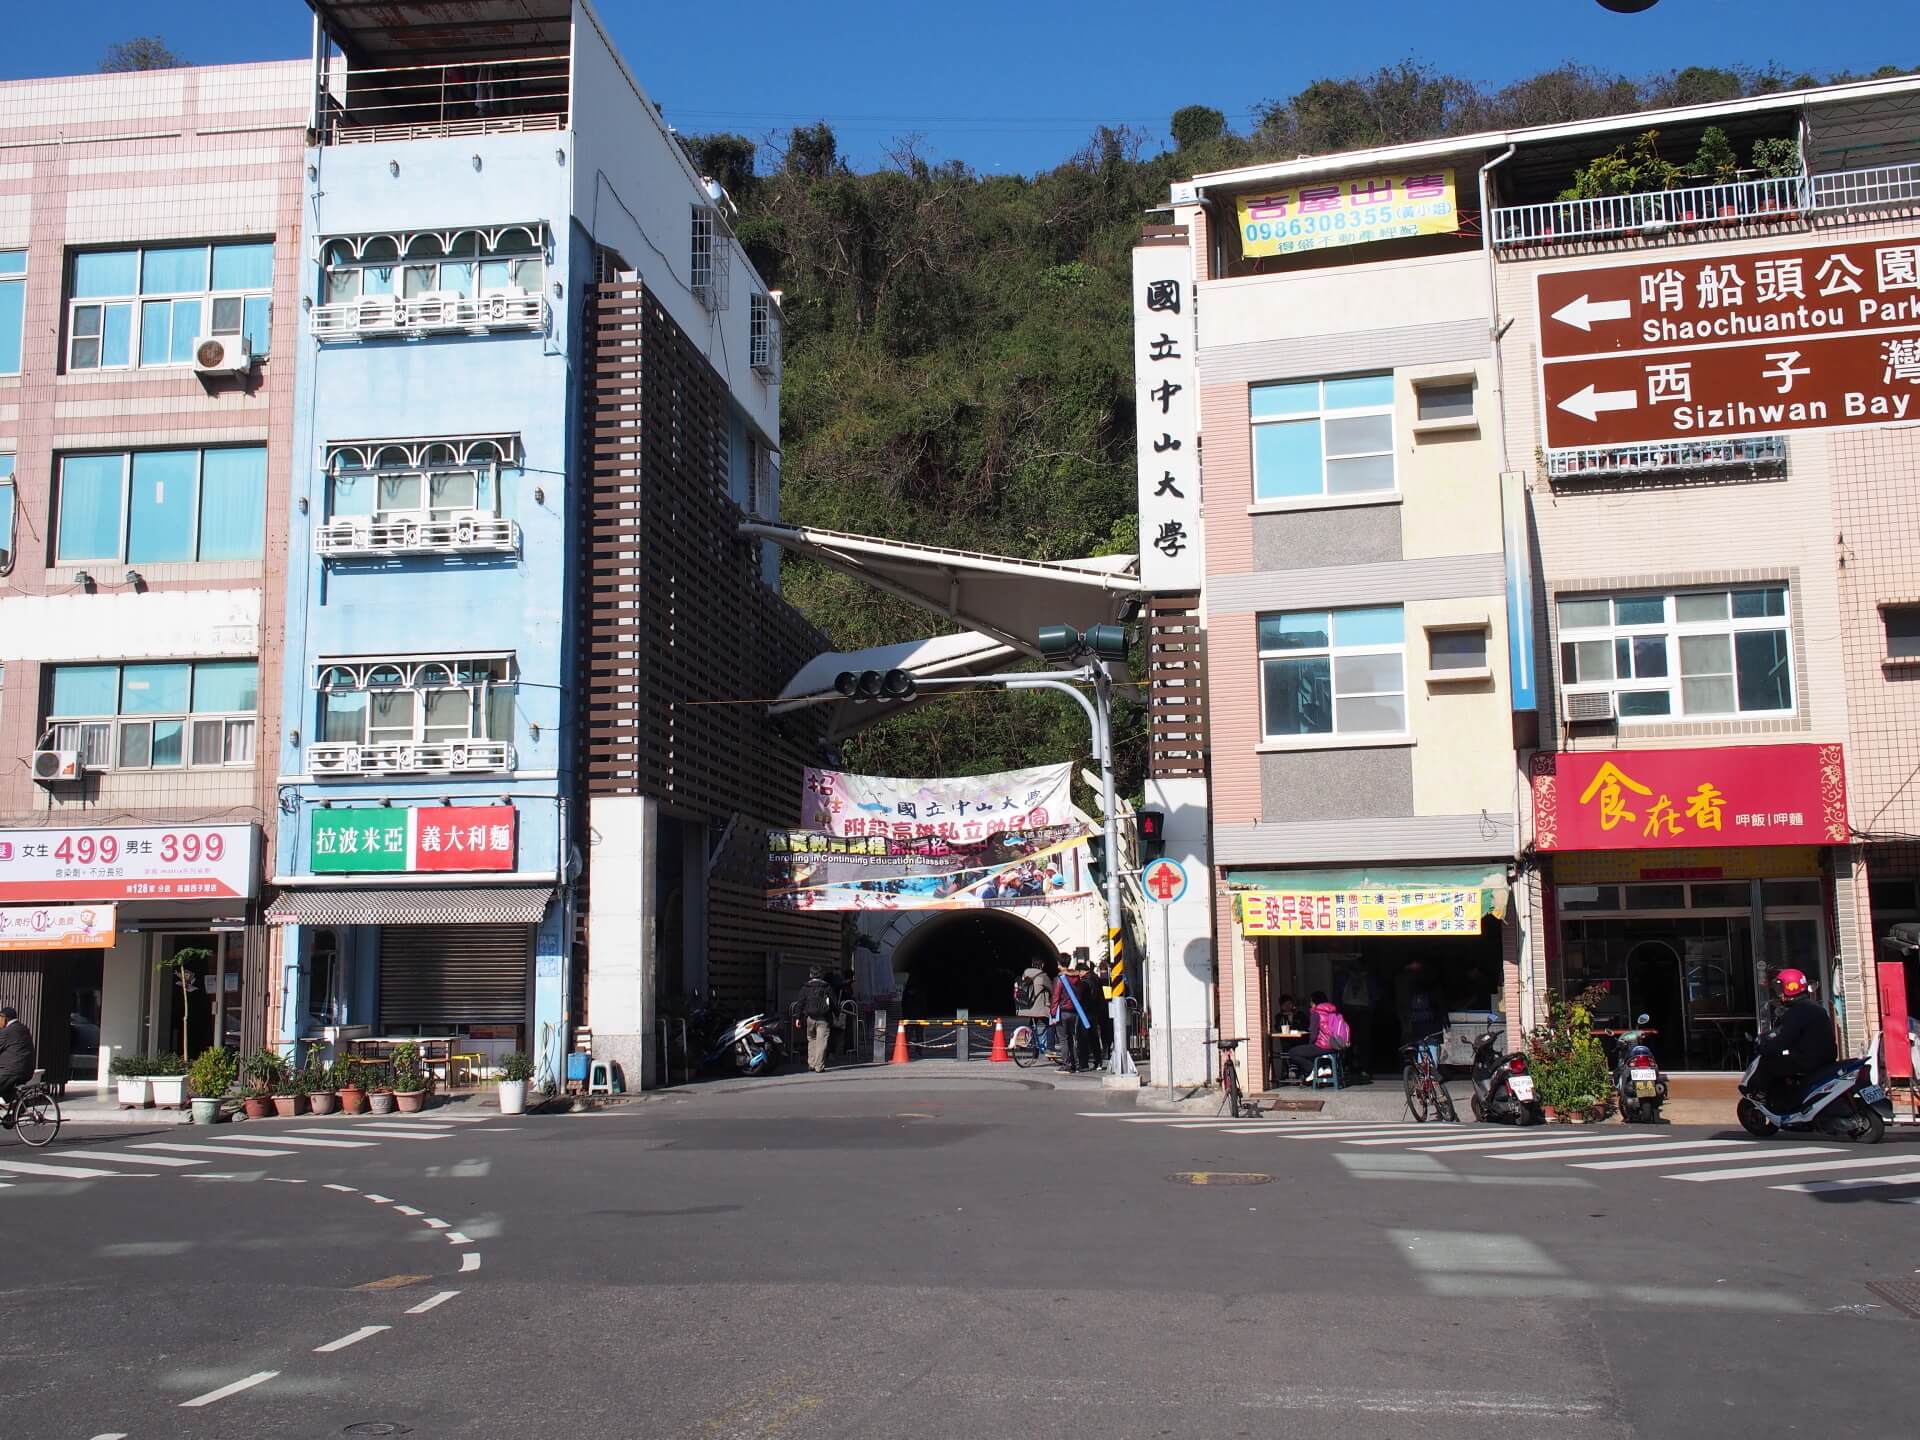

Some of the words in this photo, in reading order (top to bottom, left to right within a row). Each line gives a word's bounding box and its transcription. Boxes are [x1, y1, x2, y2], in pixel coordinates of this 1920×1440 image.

[1246, 174, 1445, 221] 吉屋出售
[1245, 206, 1393, 243] 0986308355
[1639, 246, 1920, 314] 哨船頭公園
[1642, 304, 1844, 342] Shaochuantou
[1146, 279, 1187, 558] 國立中山大學
[1673, 398, 1827, 430] Sizihwan
[1845, 392, 1911, 420] Bay
[897, 788, 1042, 819] 國立中山大學
[1579, 760, 1727, 838] 食在香
[22, 844, 49, 858] 女生
[54, 835, 120, 865] 499
[126, 840, 153, 855] 男生
[159, 832, 225, 863] 399
[316, 826, 404, 855] 拉波米亞
[421, 823, 511, 852] 義大利麵
[769, 854, 809, 864] Enrolling
[811, 854, 820, 863] in
[821, 854, 868, 865] Continuing
[870, 855, 915, 865] Education
[916, 855, 950, 866] Classes
[1247, 895, 1331, 930] 三發早餐店
